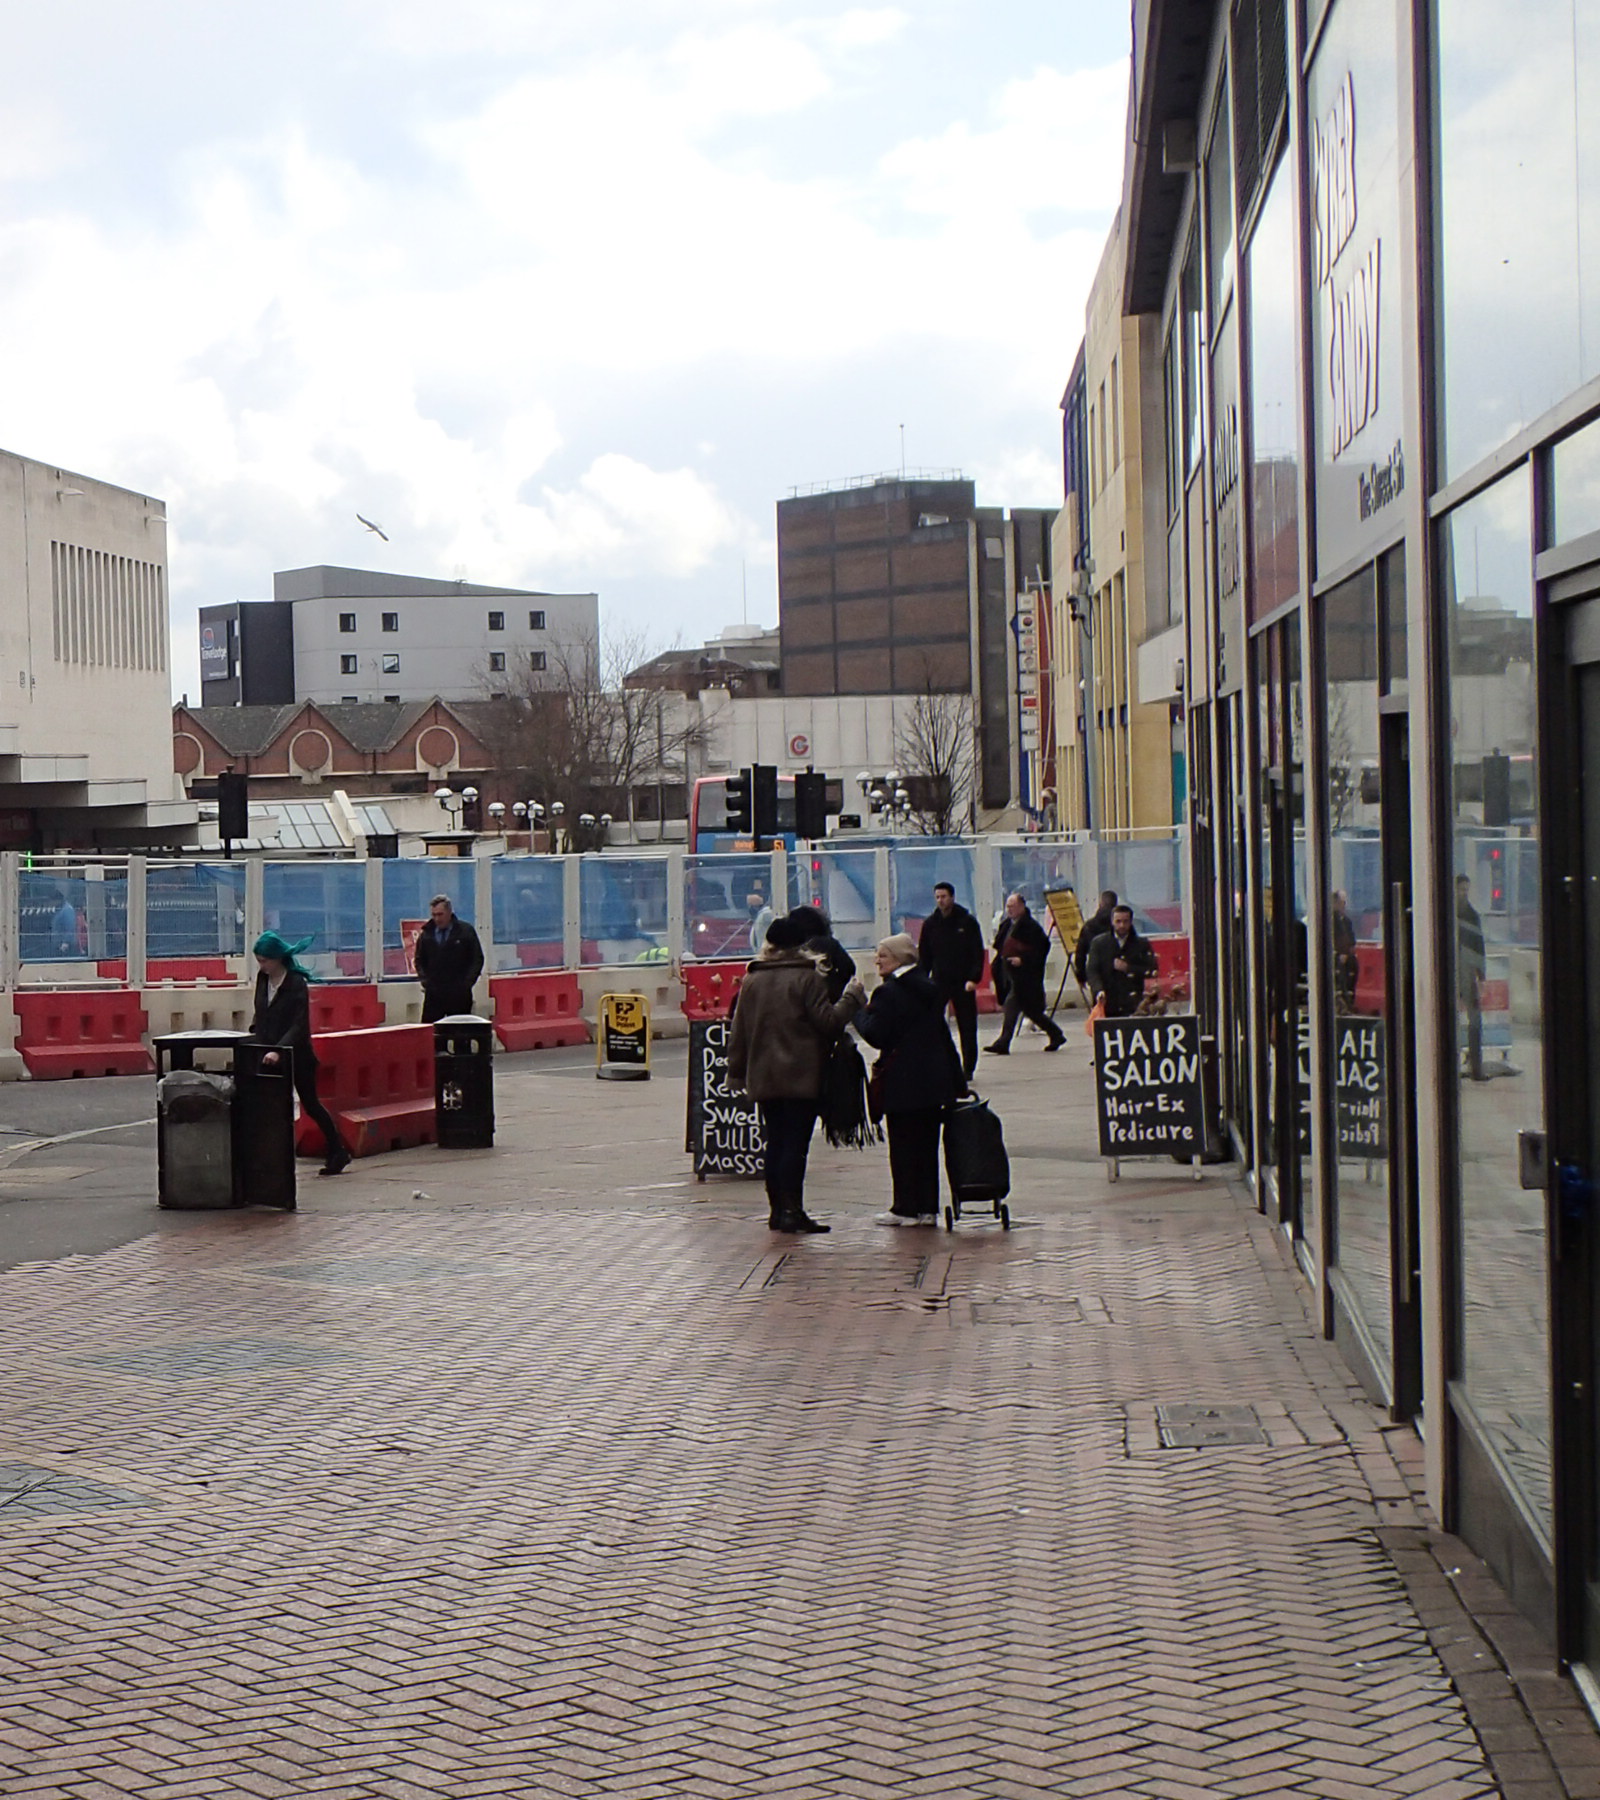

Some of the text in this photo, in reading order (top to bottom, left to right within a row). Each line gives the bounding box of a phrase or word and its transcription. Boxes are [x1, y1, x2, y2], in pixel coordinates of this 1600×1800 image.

[1103, 1024, 1187, 1059] HAIR
[1103, 1054, 1198, 1090] SALON
[1108, 1121, 1194, 1144] Pedicure
